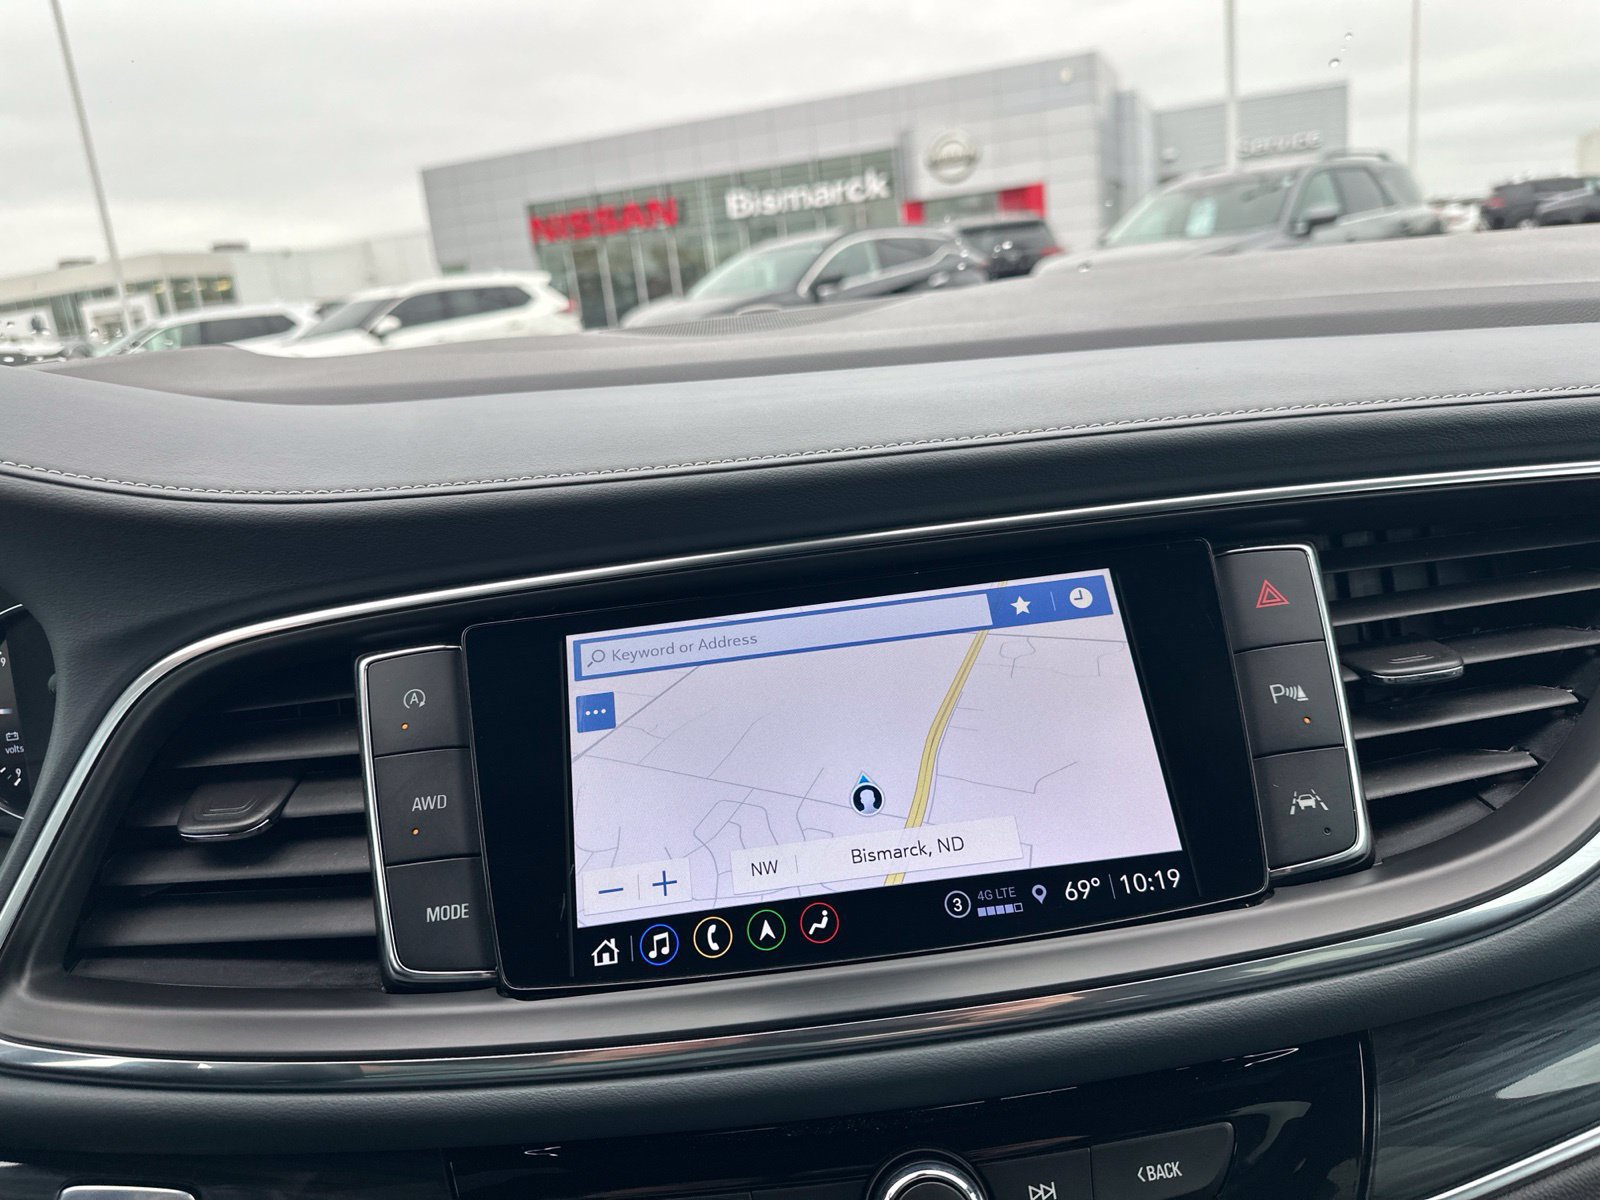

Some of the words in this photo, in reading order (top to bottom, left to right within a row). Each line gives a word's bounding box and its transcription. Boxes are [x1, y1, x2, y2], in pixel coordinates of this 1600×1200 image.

[725, 170, 889, 221] Bismarck
[530, 197, 678, 244] NISSAN
[612, 641, 674, 664] Keyword
[680, 640, 693, 653] or
[698, 634, 757, 651] Address
[5, 741, 24, 754] volts
[412, 794, 447, 812] AWD
[851, 839, 932, 865] Bismarck,
[937, 836, 964, 854] ND
[751, 860, 779, 877] NW
[977, 888, 993, 901] 4G
[996, 886, 1017, 900] LTE
[1065, 877, 1101, 902] 69°
[1119, 868, 1181, 896] 10:19
[426, 903, 469, 923] MODE
